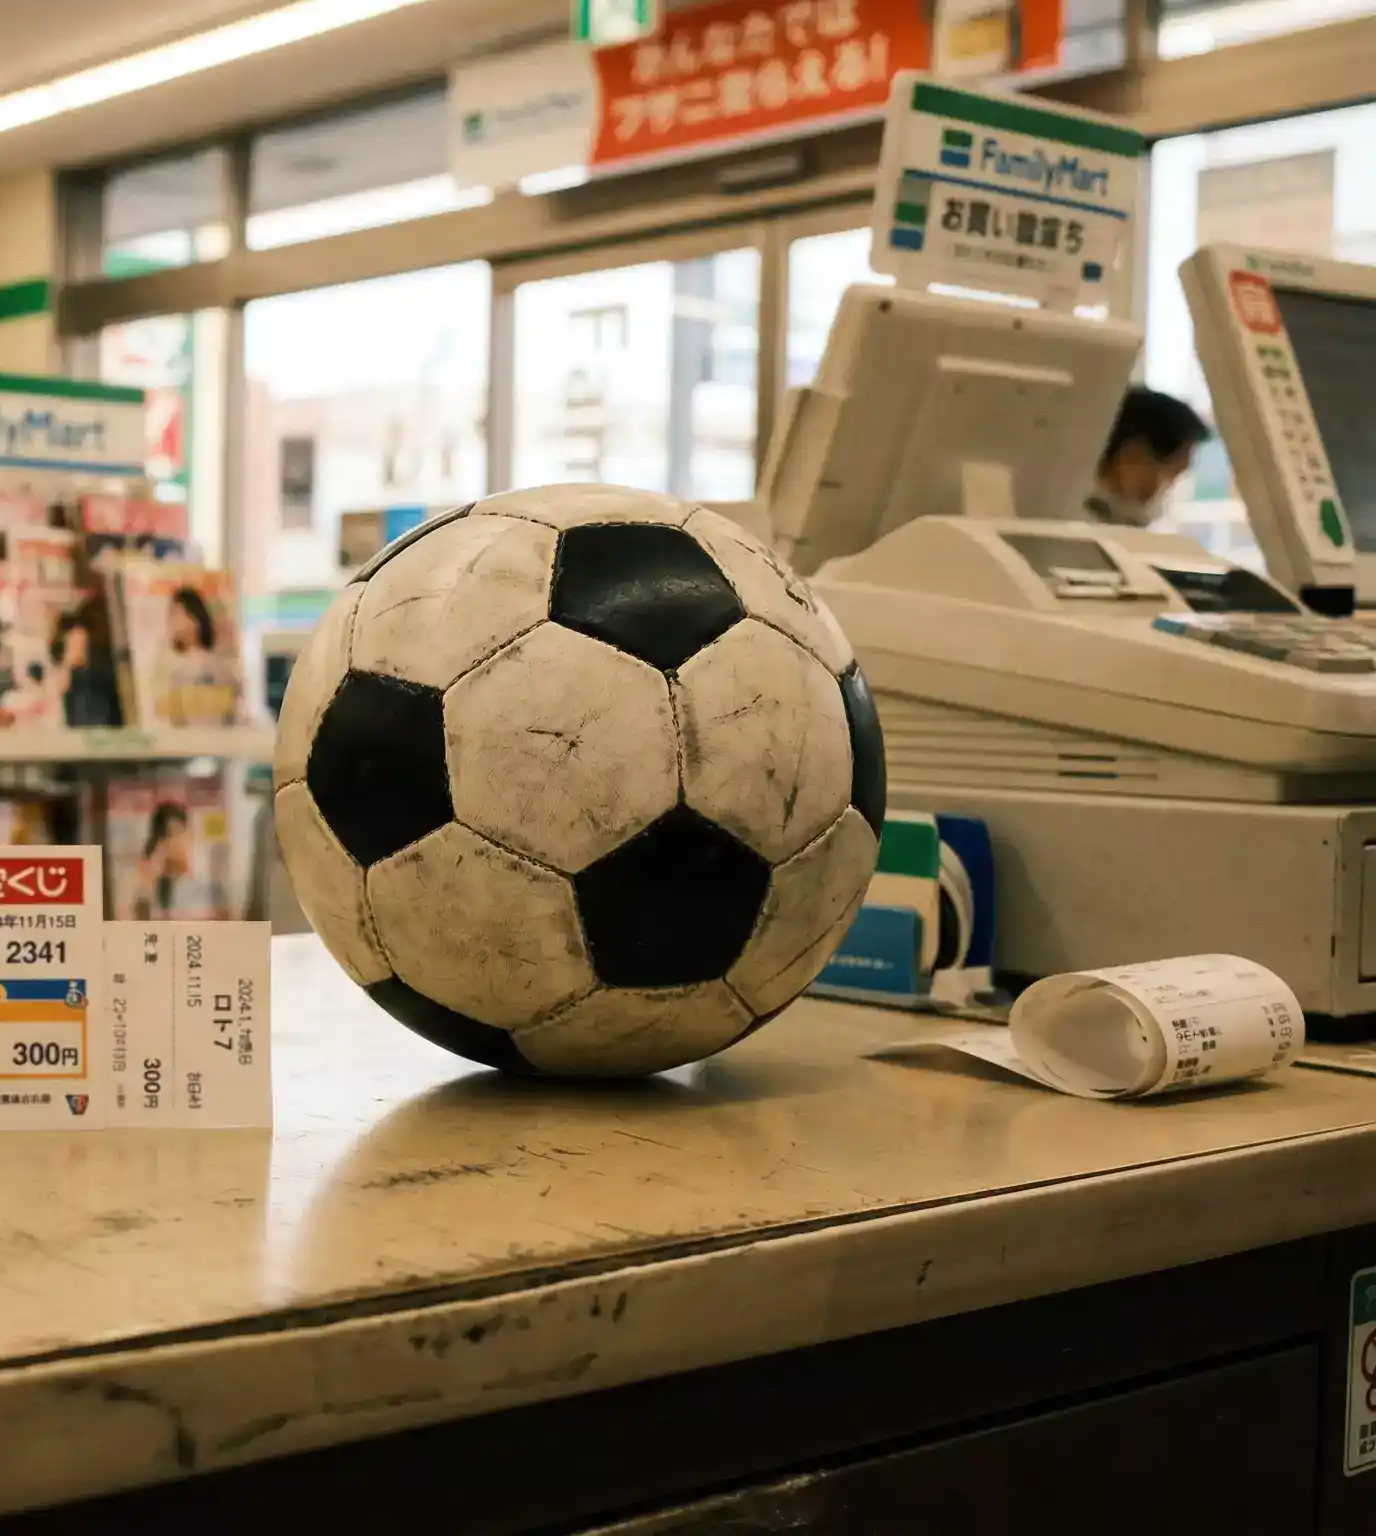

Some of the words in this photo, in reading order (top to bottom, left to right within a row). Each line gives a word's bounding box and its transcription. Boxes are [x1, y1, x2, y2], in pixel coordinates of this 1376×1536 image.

[980, 137, 1109, 197] FamilyMart
[6, 941, 66, 964] 2341
[213, 994, 233, 1051] ロト7
[13, 1043, 78, 1067] 300円
[143, 1059, 162, 1109] 300円
